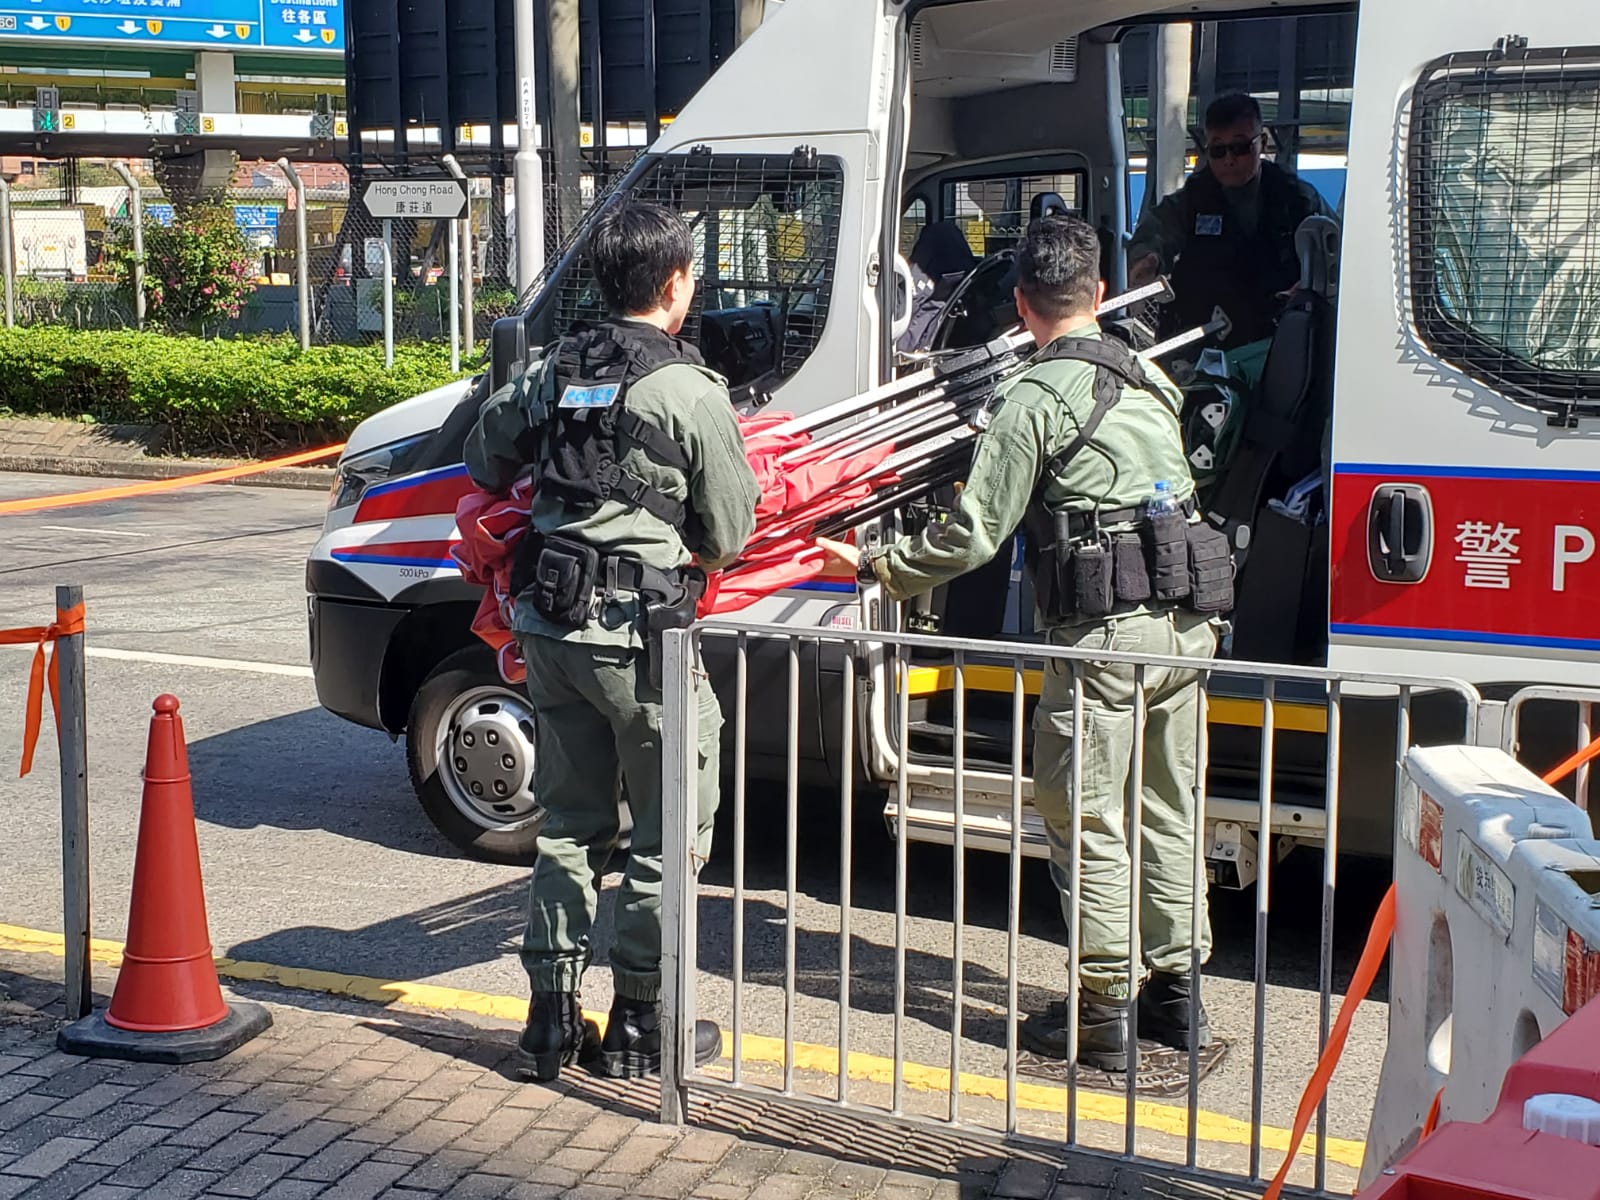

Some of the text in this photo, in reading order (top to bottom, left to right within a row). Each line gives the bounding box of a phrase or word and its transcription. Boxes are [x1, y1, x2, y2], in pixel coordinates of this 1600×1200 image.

[64, 116, 73, 127] 2
[202, 119, 212, 131] 3
[336, 123, 346, 134] 4
[375, 184, 453, 197] Hong Chong Road
[1454, 521, 1596, 592] 警 P
[399, 568, 414, 577] 500
